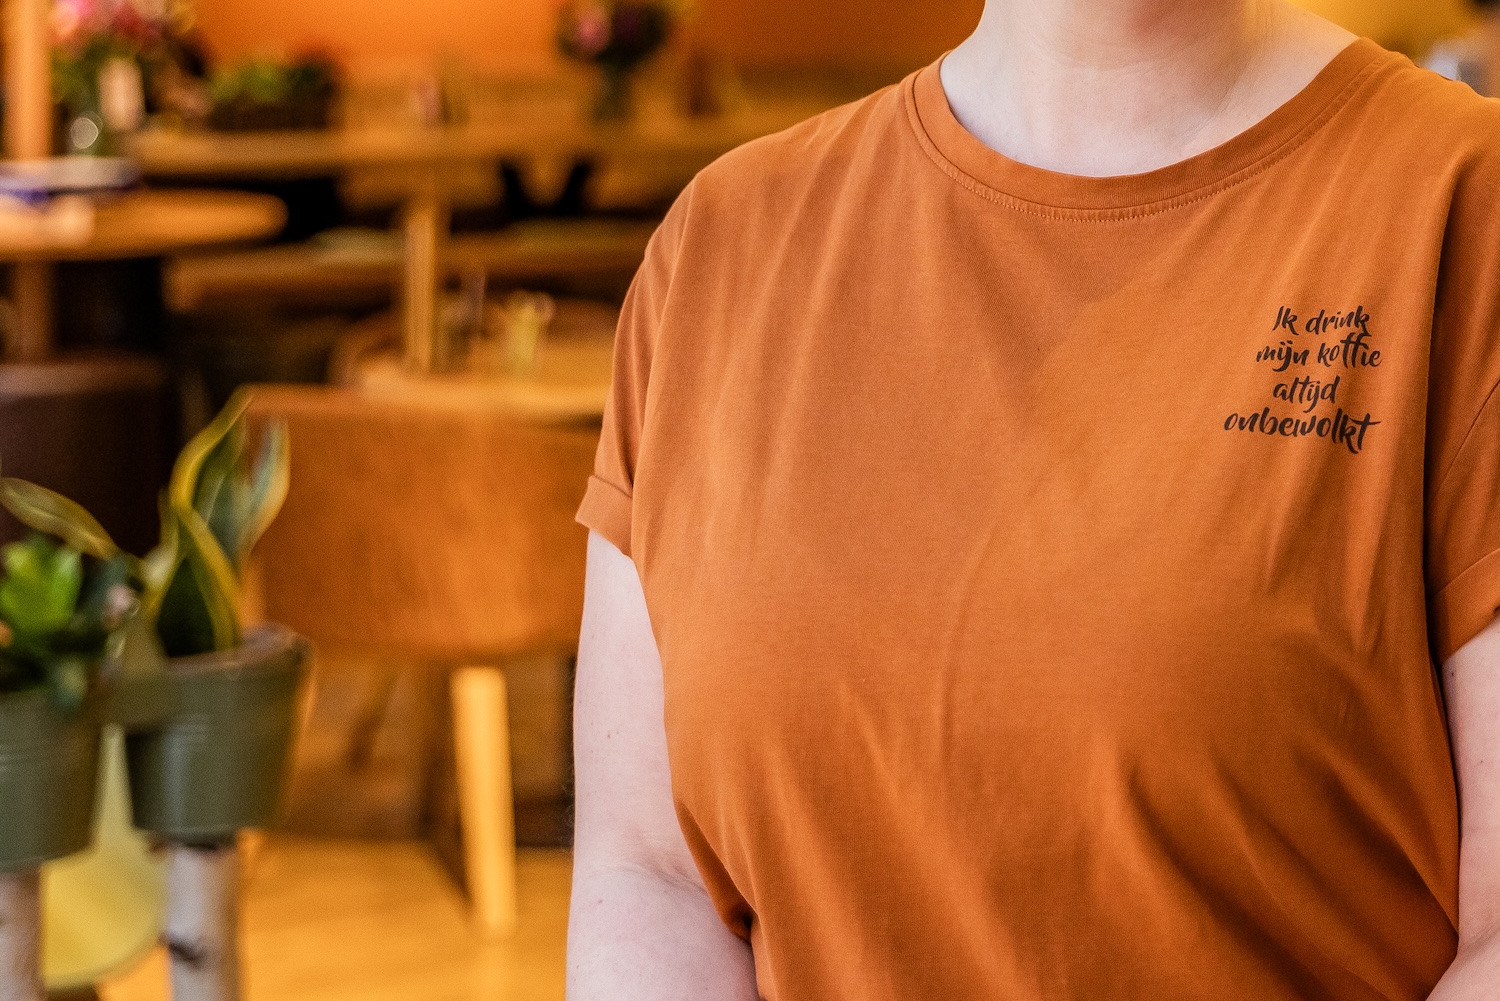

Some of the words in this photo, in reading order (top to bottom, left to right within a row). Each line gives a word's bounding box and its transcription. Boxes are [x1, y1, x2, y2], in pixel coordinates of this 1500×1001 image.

[1272, 305, 1300, 336] Ik
[1305, 305, 1372, 337] drink
[1256, 340, 1310, 372] mijn
[1317, 332, 1382, 368] koffie
[1272, 375, 1341, 413] altijd
[1224, 406, 1382, 455] onbewolkt
